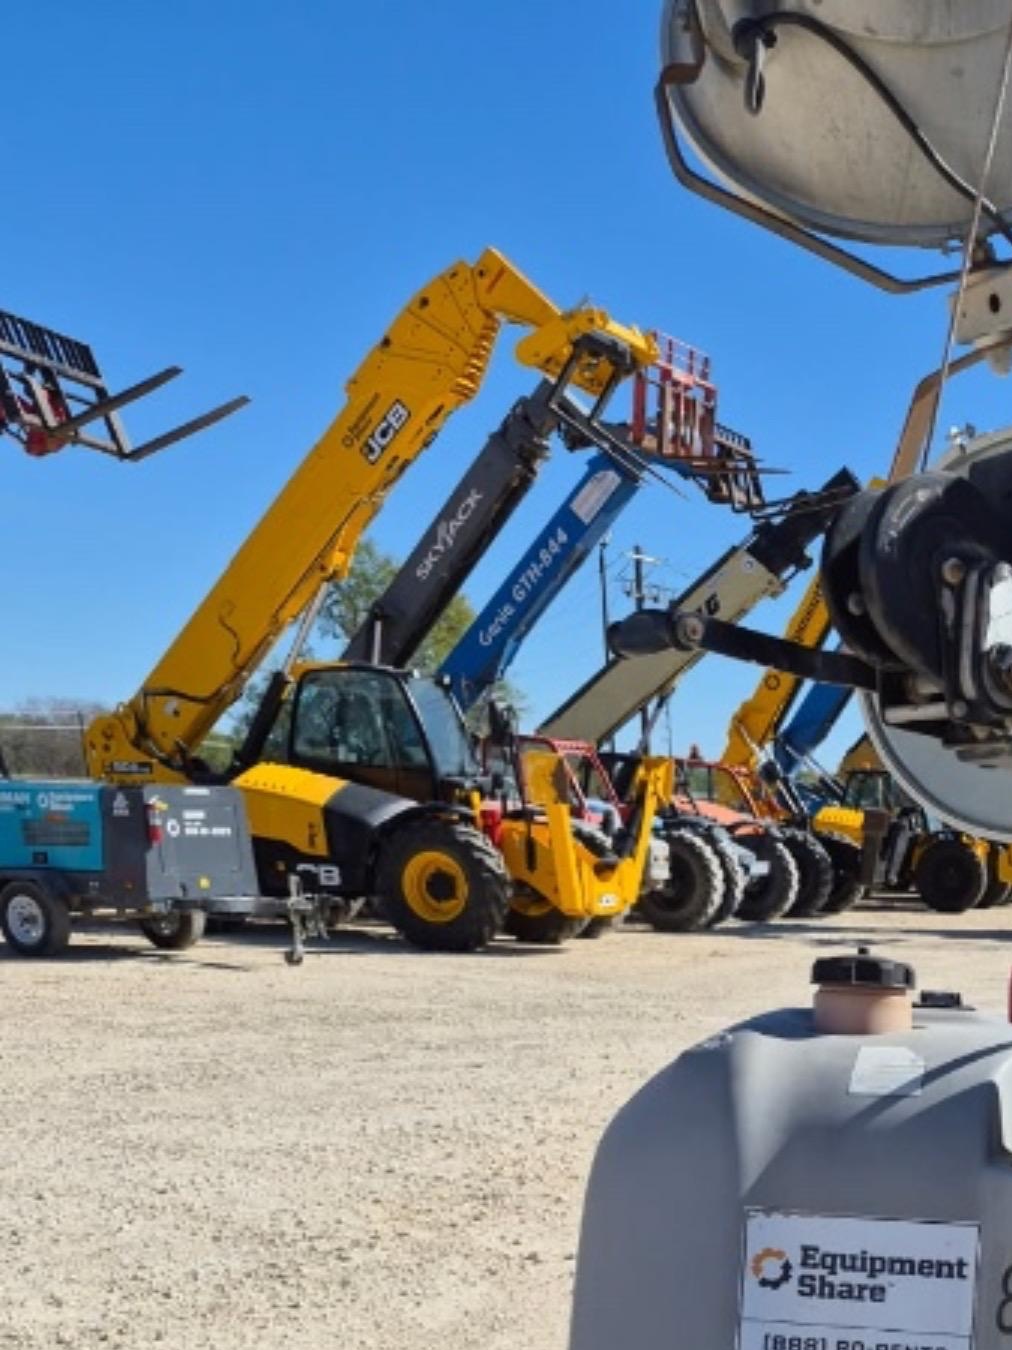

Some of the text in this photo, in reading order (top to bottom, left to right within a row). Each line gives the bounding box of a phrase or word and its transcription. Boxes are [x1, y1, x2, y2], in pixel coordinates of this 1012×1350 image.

[363, 402, 409, 462] JCB
[415, 488, 483, 581] SKYJACK
[479, 527, 568, 646] Genie GTH-844
[797, 1274, 886, 1303] Share
[799, 1244, 968, 1280] Equipment
